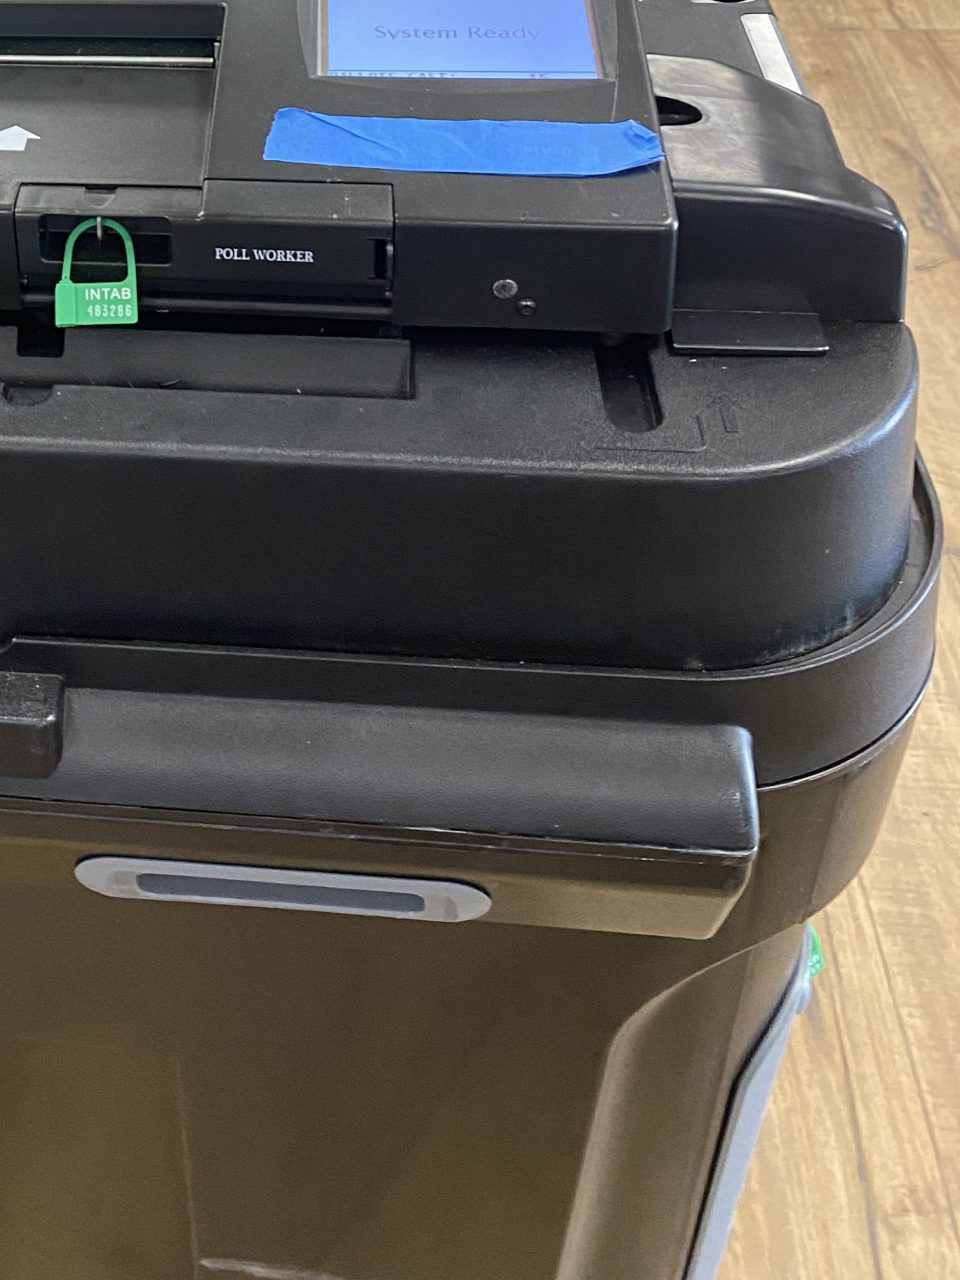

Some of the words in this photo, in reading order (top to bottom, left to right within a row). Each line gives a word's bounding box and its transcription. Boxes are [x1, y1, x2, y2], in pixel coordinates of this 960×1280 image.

[374, 26, 458, 40] System
[468, 26, 542, 41] Ready
[215, 248, 250, 261] POLL
[252, 249, 314, 263] WORKER
[85, 287, 132, 301] INTAB
[87, 304, 132, 317] 483286
